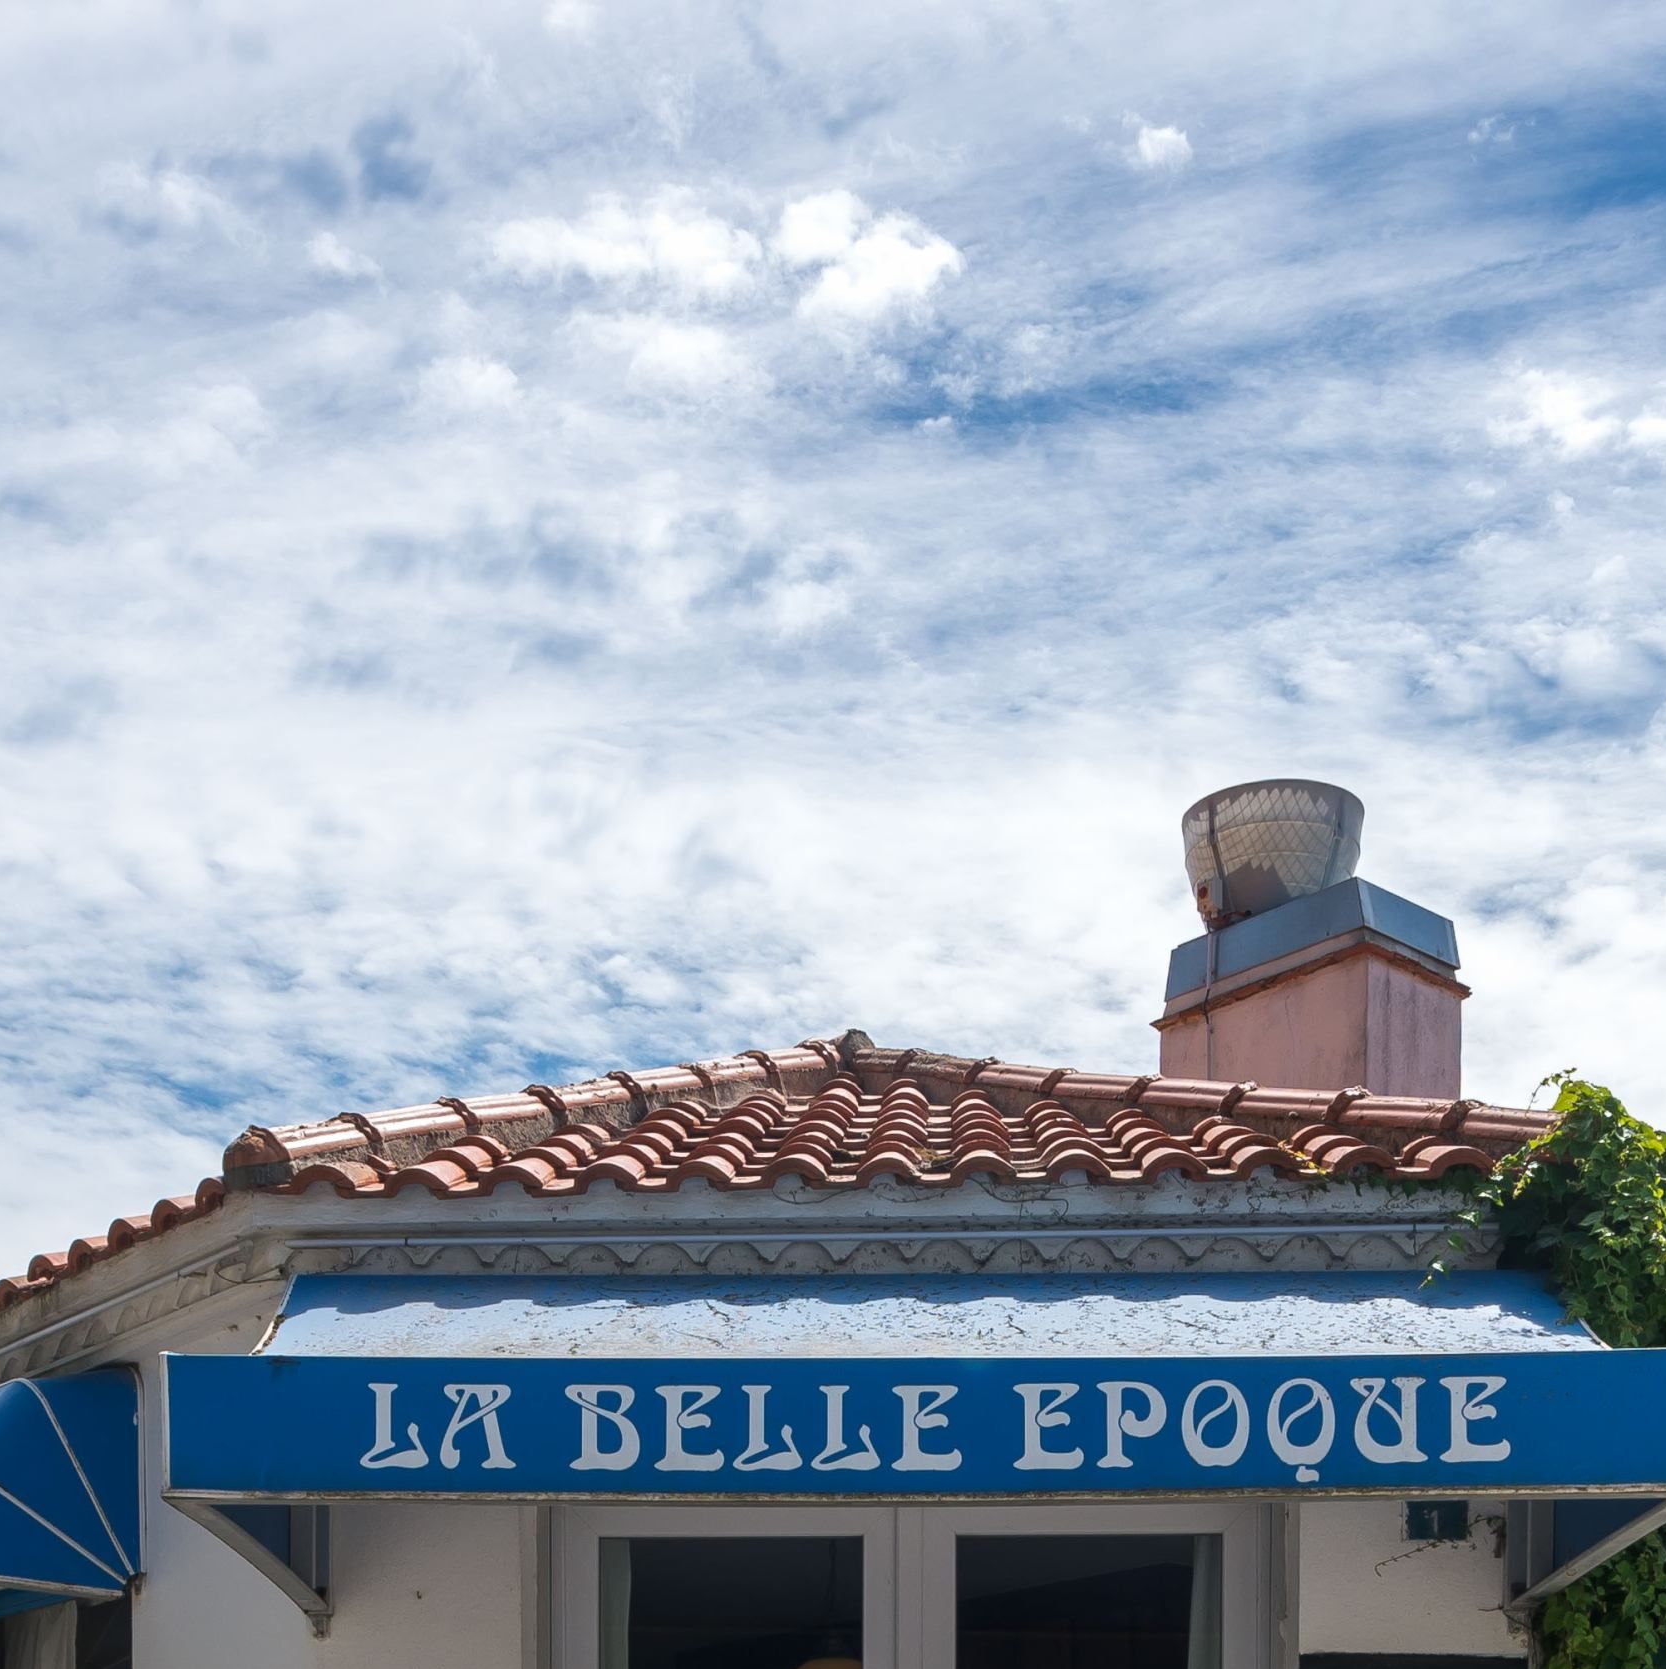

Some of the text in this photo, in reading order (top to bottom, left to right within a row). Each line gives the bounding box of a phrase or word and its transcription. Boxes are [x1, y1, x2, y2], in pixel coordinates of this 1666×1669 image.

[359, 1376, 1511, 1483] LA BELLE EPOQUE
